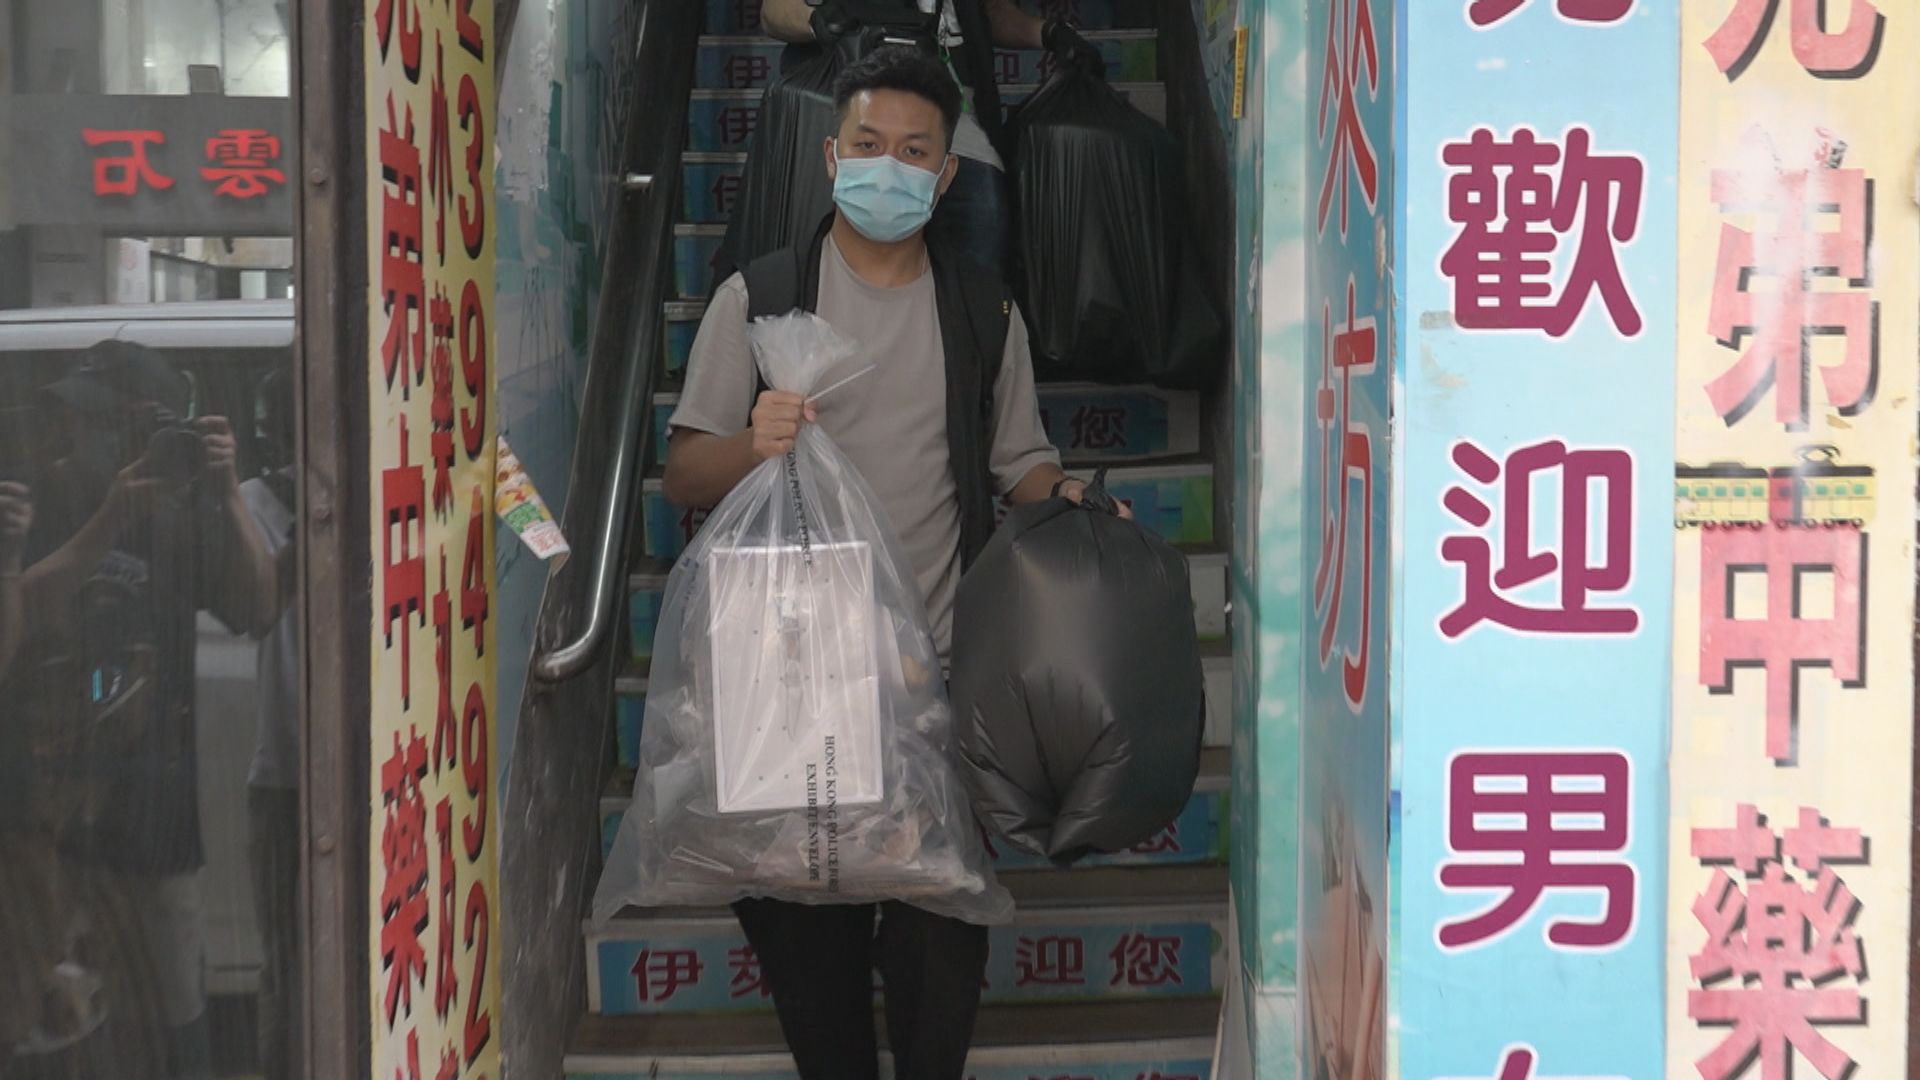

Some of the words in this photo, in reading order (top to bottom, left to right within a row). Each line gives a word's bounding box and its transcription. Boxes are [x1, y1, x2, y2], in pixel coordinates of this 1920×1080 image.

[786, 447, 798, 477] ONG
[375, 0, 427, 1080] 弟中藥
[1438, 0, 1645, 1080] 歡迎男
[824, 735, 836, 777] HONG
[806, 763, 818, 820] EXHIBIT
[825, 779, 838, 819] KONG
[827, 822, 839, 866] POLICE
